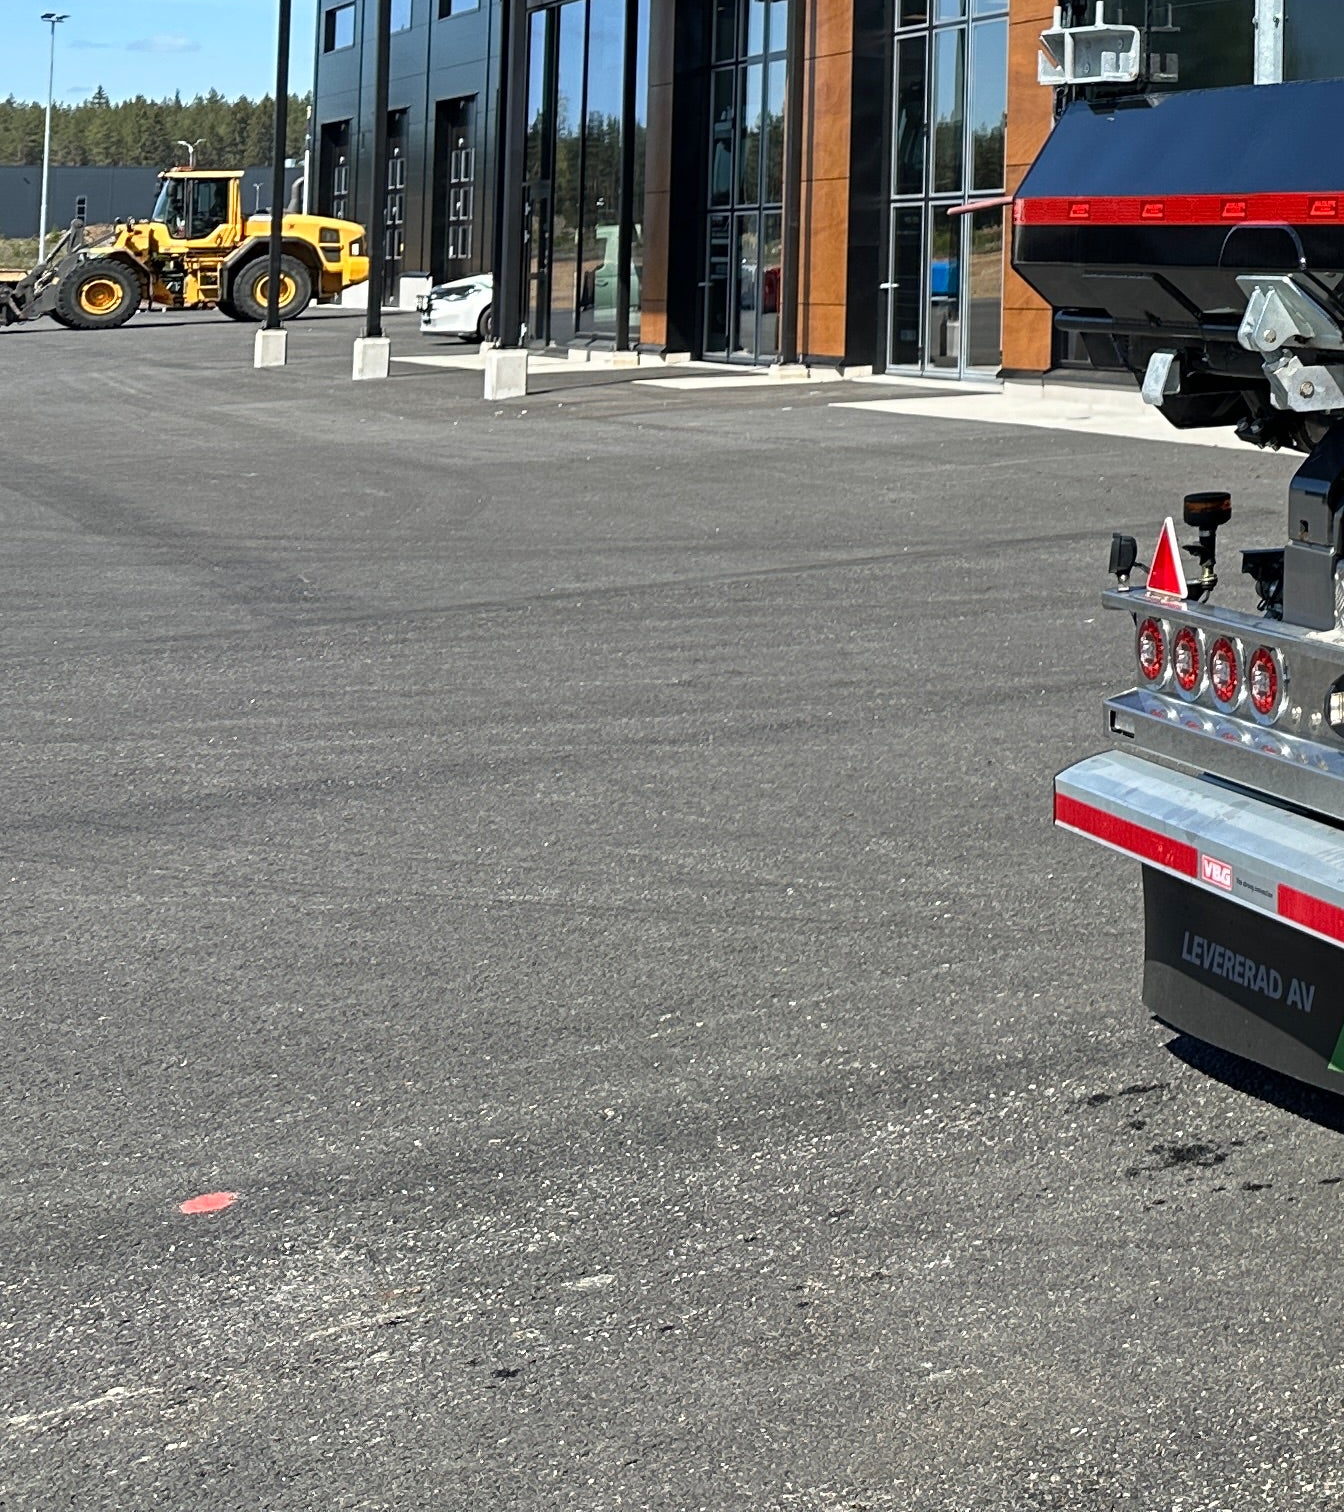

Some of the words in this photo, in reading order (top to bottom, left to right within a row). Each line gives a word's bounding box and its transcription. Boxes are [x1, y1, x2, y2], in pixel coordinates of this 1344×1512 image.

[1203, 859, 1231, 886] VBG
[1181, 931, 1284, 1001] LEVERERAD
[1286, 978, 1315, 1013] AV
